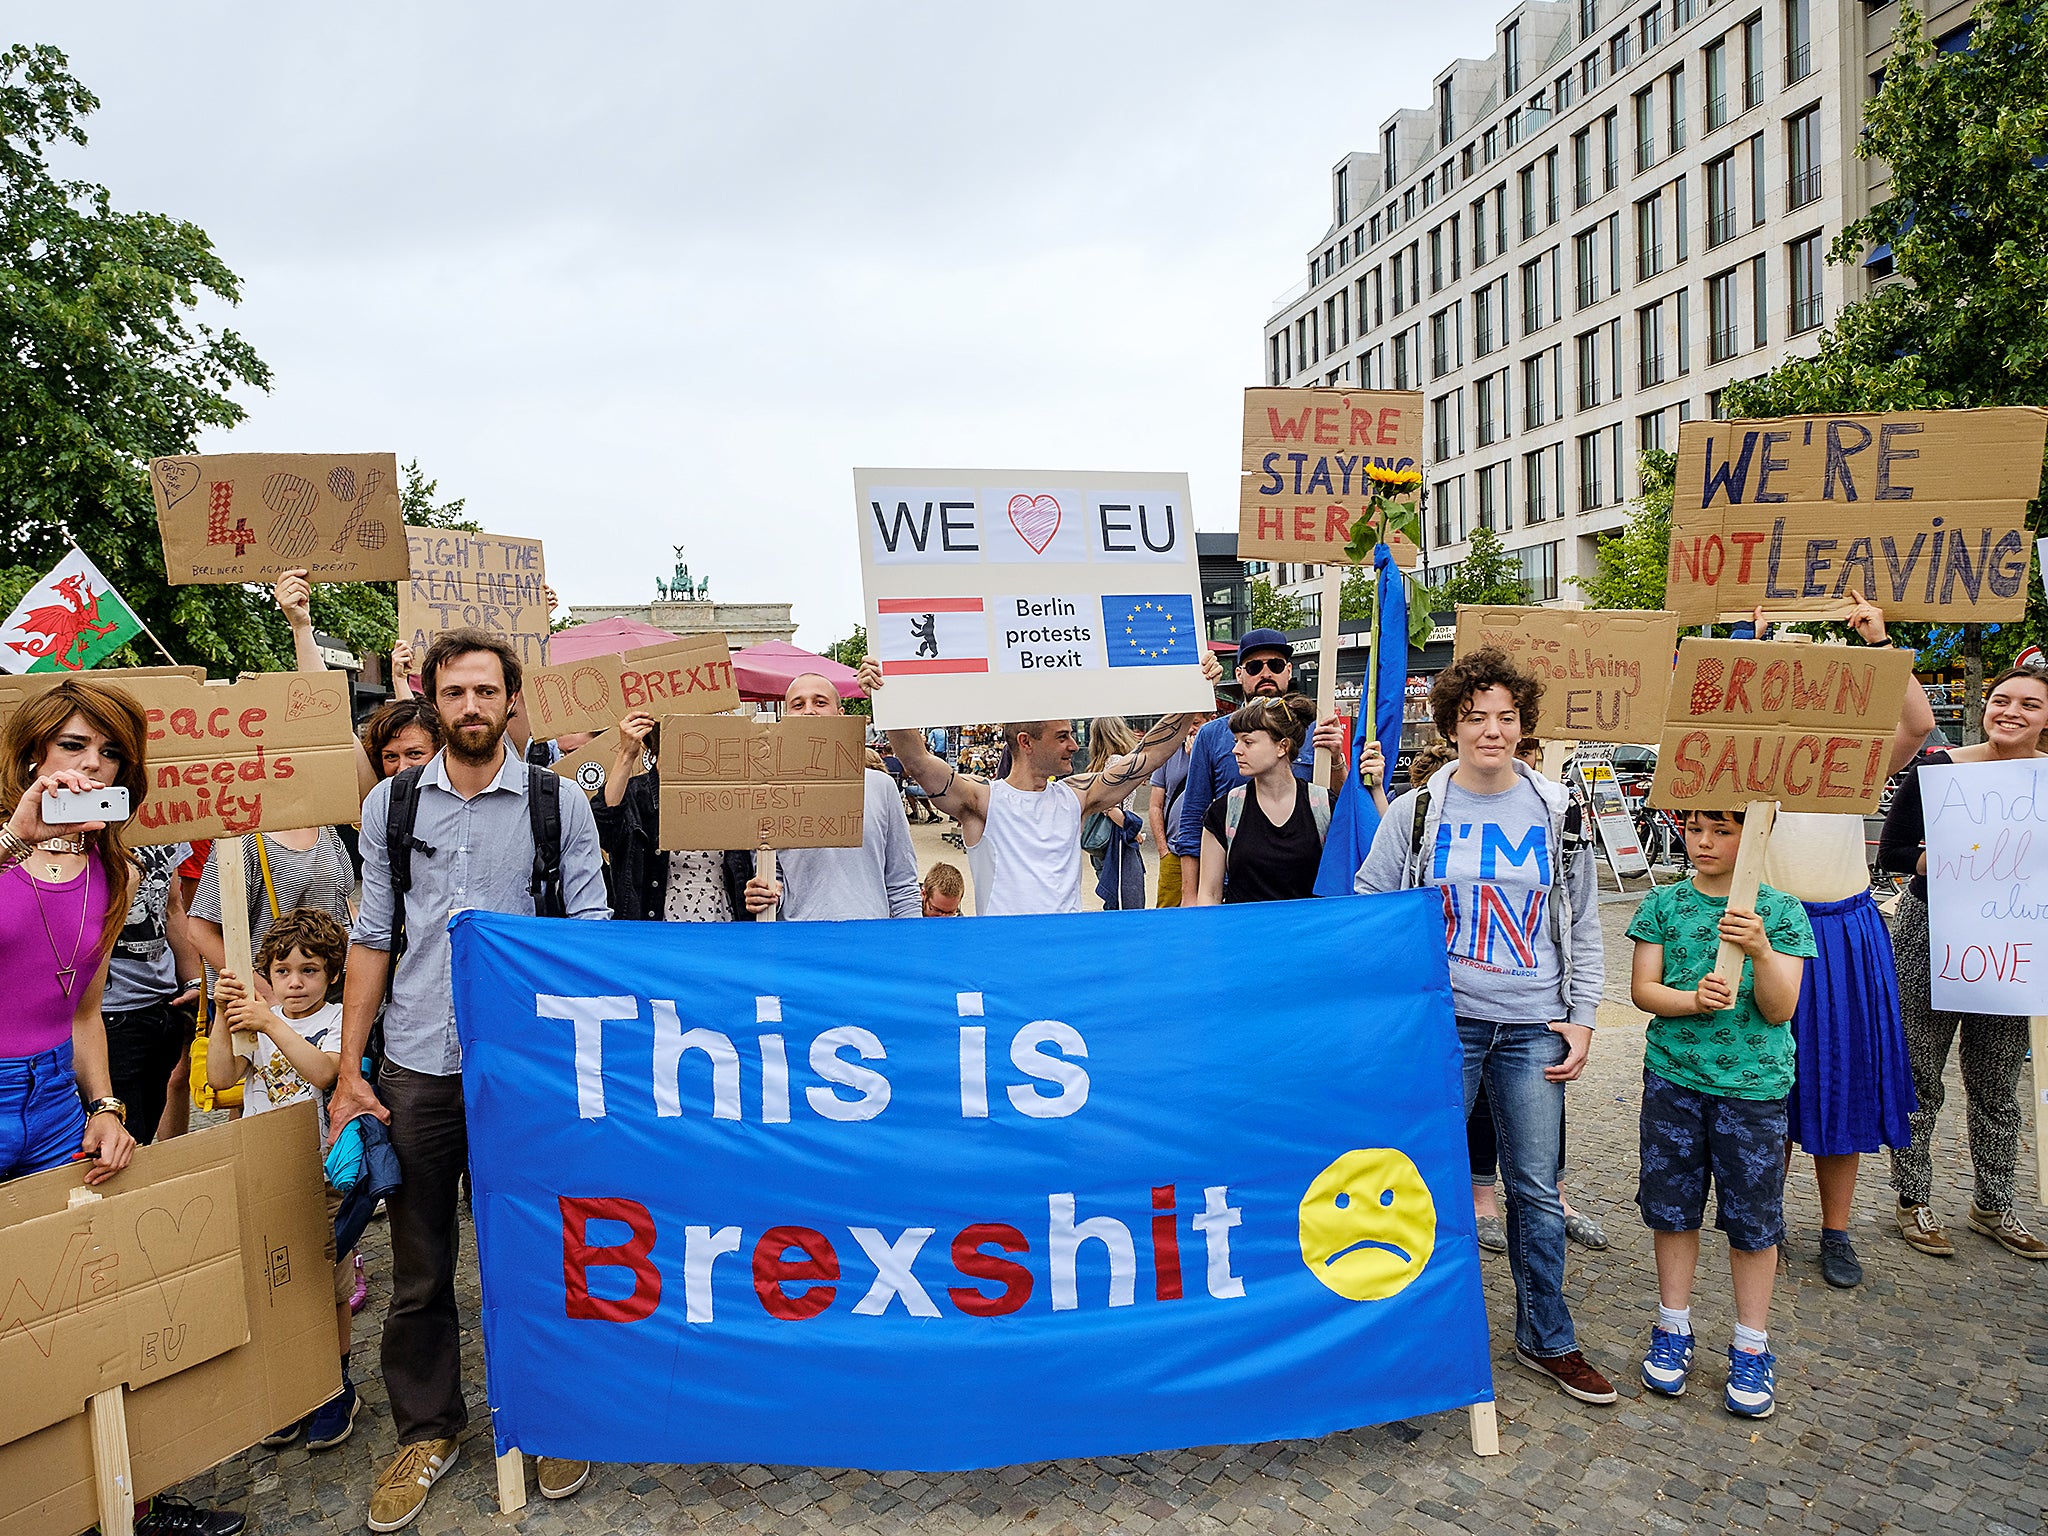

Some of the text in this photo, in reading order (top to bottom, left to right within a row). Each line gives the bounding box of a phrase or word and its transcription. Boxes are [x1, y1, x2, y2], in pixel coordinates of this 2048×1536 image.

[1267, 398, 1401, 446] WE'RE
[162, 462, 187, 476] BRITS
[166, 473, 179, 481] FOR
[1701, 420, 1925, 509] WE'RE
[206, 466, 386, 559] 48%
[871, 501, 1176, 553] WE EU
[192, 564, 244, 575] BERLINERS
[312, 562, 358, 572] BREXIT
[408, 536, 539, 570] FIGHT THE
[1672, 532, 1765, 586] NOT
[411, 569, 542, 606] REAL ENEMY
[1016, 598, 1075, 617] Berlin
[428, 602, 523, 631] TORY
[1006, 626, 1091, 648] protests
[1020, 650, 1082, 669] Brexit
[1526, 648, 1642, 698] nothing
[619, 661, 733, 708] BREXIT
[1689, 656, 1876, 717] BROWN
[146, 707, 267, 740] eace
[1565, 689, 1632, 731] EU!
[157, 745, 295, 788] needs
[677, 731, 864, 779] BERLIN
[1670, 730, 1884, 800] SAUCE!
[138, 785, 263, 833] unity
[679, 783, 806, 815] PROTEST
[1932, 770, 2047, 824] And
[757, 809, 864, 840] BREXIT
[1433, 823, 1550, 886] I'M
[1936, 828, 2032, 881] will
[1437, 884, 1547, 968] IN
[1938, 942, 2033, 984] LOVE
[536, 992, 1090, 1124] This is
[557, 1184, 1246, 1324] Brexshit
[140, 1323, 187, 1371] EU
